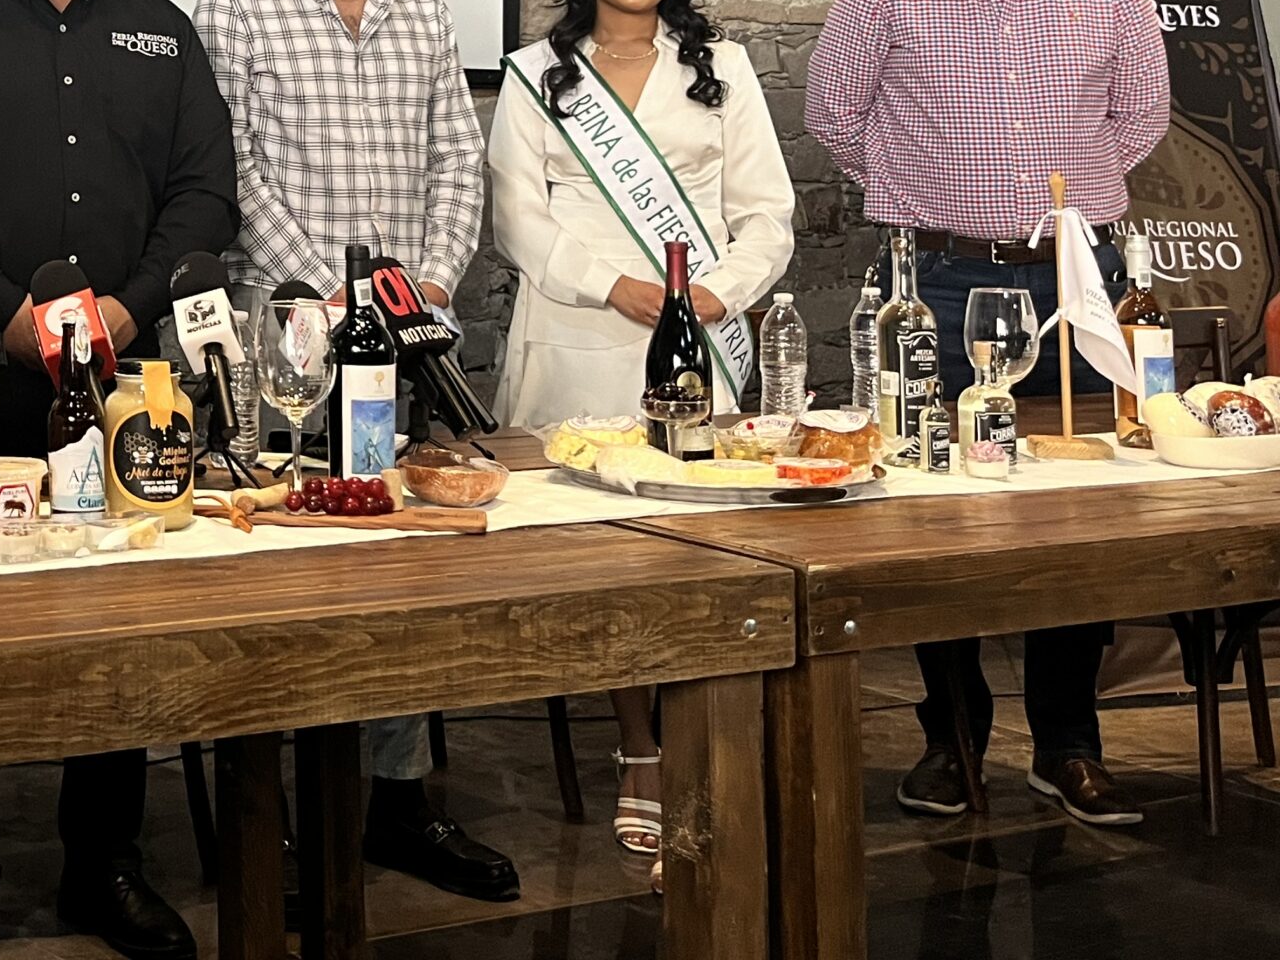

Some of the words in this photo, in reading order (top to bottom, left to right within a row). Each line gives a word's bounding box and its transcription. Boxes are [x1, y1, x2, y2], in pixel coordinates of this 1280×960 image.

[111, 32, 136, 41] FERIA
[136, 32, 178, 46] REGIONAL
[111, 39, 127, 47] DEL
[126, 40, 179, 57] QUESO
[567, 93, 623, 158] REINA
[612, 158, 640, 183] de
[628, 178, 657, 211] las
[646, 204, 710, 284] FIESTA
[718, 316, 751, 382] TRIAS
[1109, 221, 1138, 236] RIA
[1143, 218, 1239, 238] REGIONAL
[398, 324, 453, 345] NOTICIAS
[125, 466, 150, 480] Miel
[152, 467, 164, 477] de
